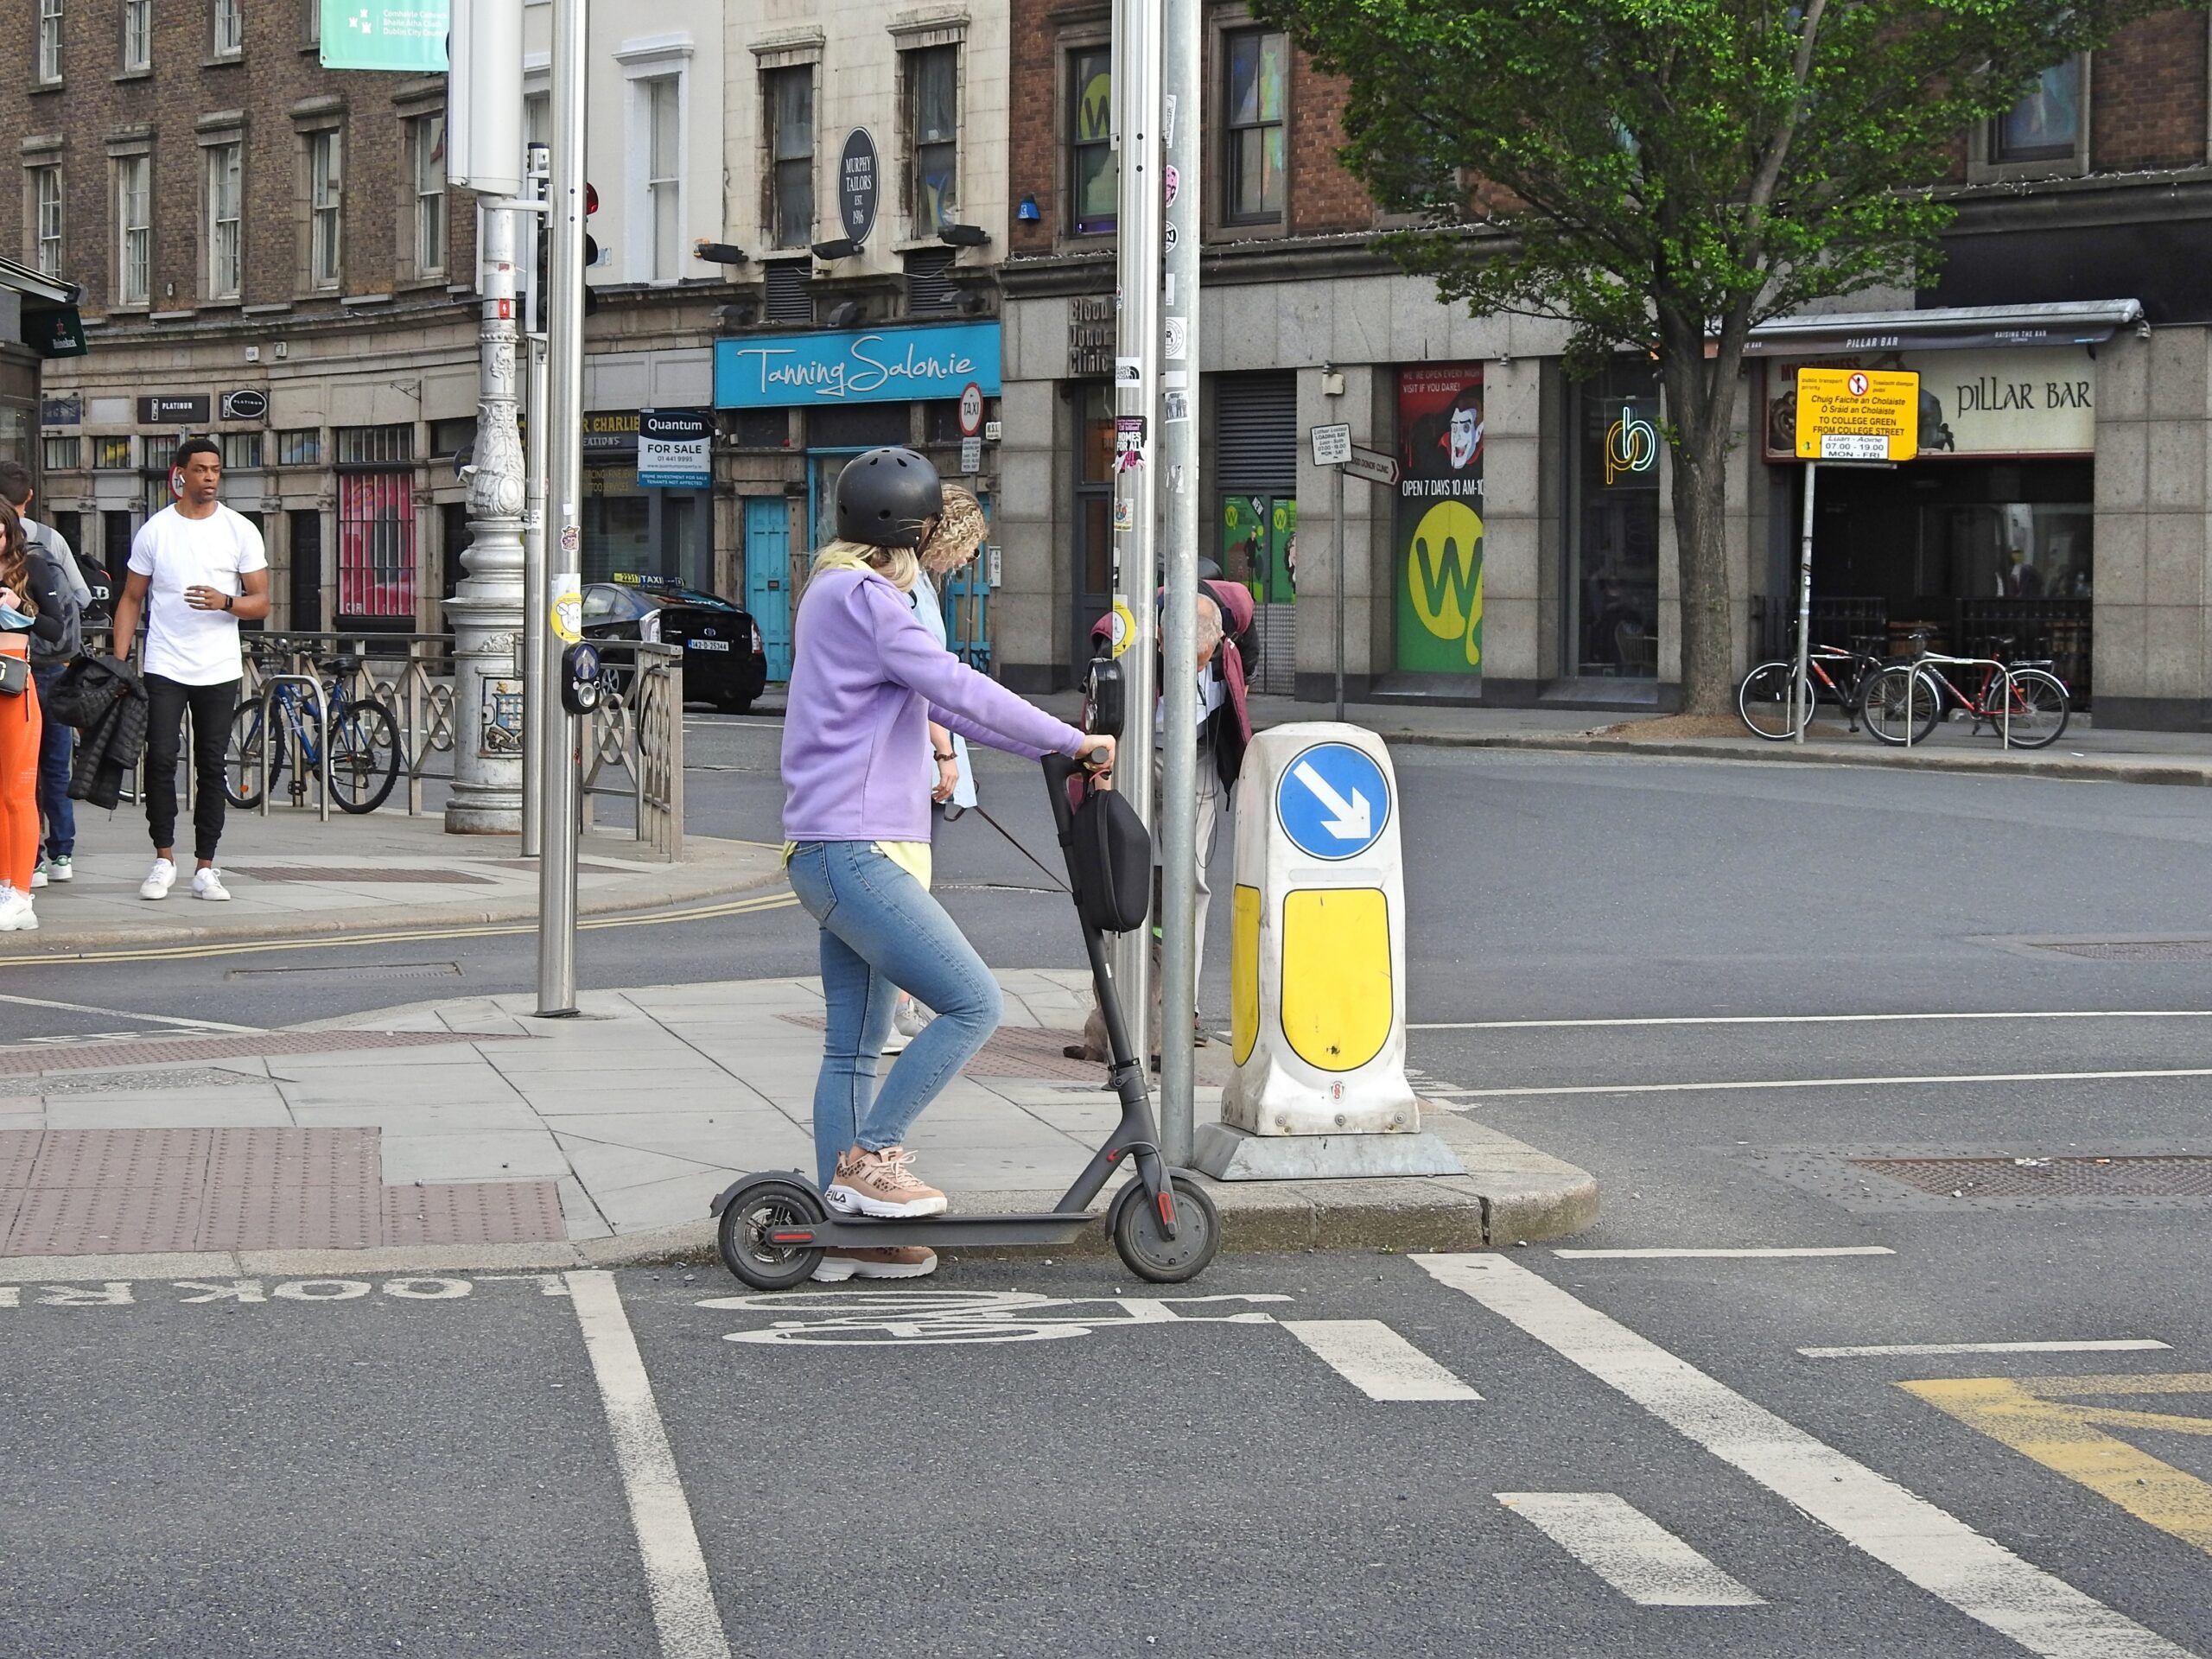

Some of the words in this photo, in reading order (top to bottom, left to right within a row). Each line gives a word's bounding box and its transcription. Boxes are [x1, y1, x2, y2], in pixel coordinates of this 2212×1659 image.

[845, 156, 872, 173] MURPHY
[845, 175, 872, 192] TAILORS
[1069, 296, 1109, 321] Blood
[1068, 325, 1108, 346] Donor
[1846, 337, 1878, 348] PILLAR
[1878, 336, 1899, 347] BAR
[1068, 348, 1109, 372] Clinic
[1444, 369, 1463, 378] EVERY
[1403, 384, 1418, 393] VISIT
[1419, 384, 1426, 392] IF
[1427, 383, 1440, 392] YOU
[1441, 383, 1460, 391] DARE!
[2047, 380, 2092, 410] BAR
[162, 402, 193, 410] PLATINUM
[1811, 395, 1833, 404] Chuig
[1834, 395, 1859, 404] Faiche
[963, 402, 979, 416] TAXI
[648, 418, 702, 431] Quantum
[647, 445, 671, 454] FOR
[674, 445, 702, 454] SALE
[1402, 480, 1423, 496] OPEN
[1424, 480, 1430, 496] 7
[1431, 480, 1450, 496] DAYS
[1452, 480, 1460, 495] 10
[641, 575, 662, 584] TAXI
[825, 1190, 847, 1204] FILA
